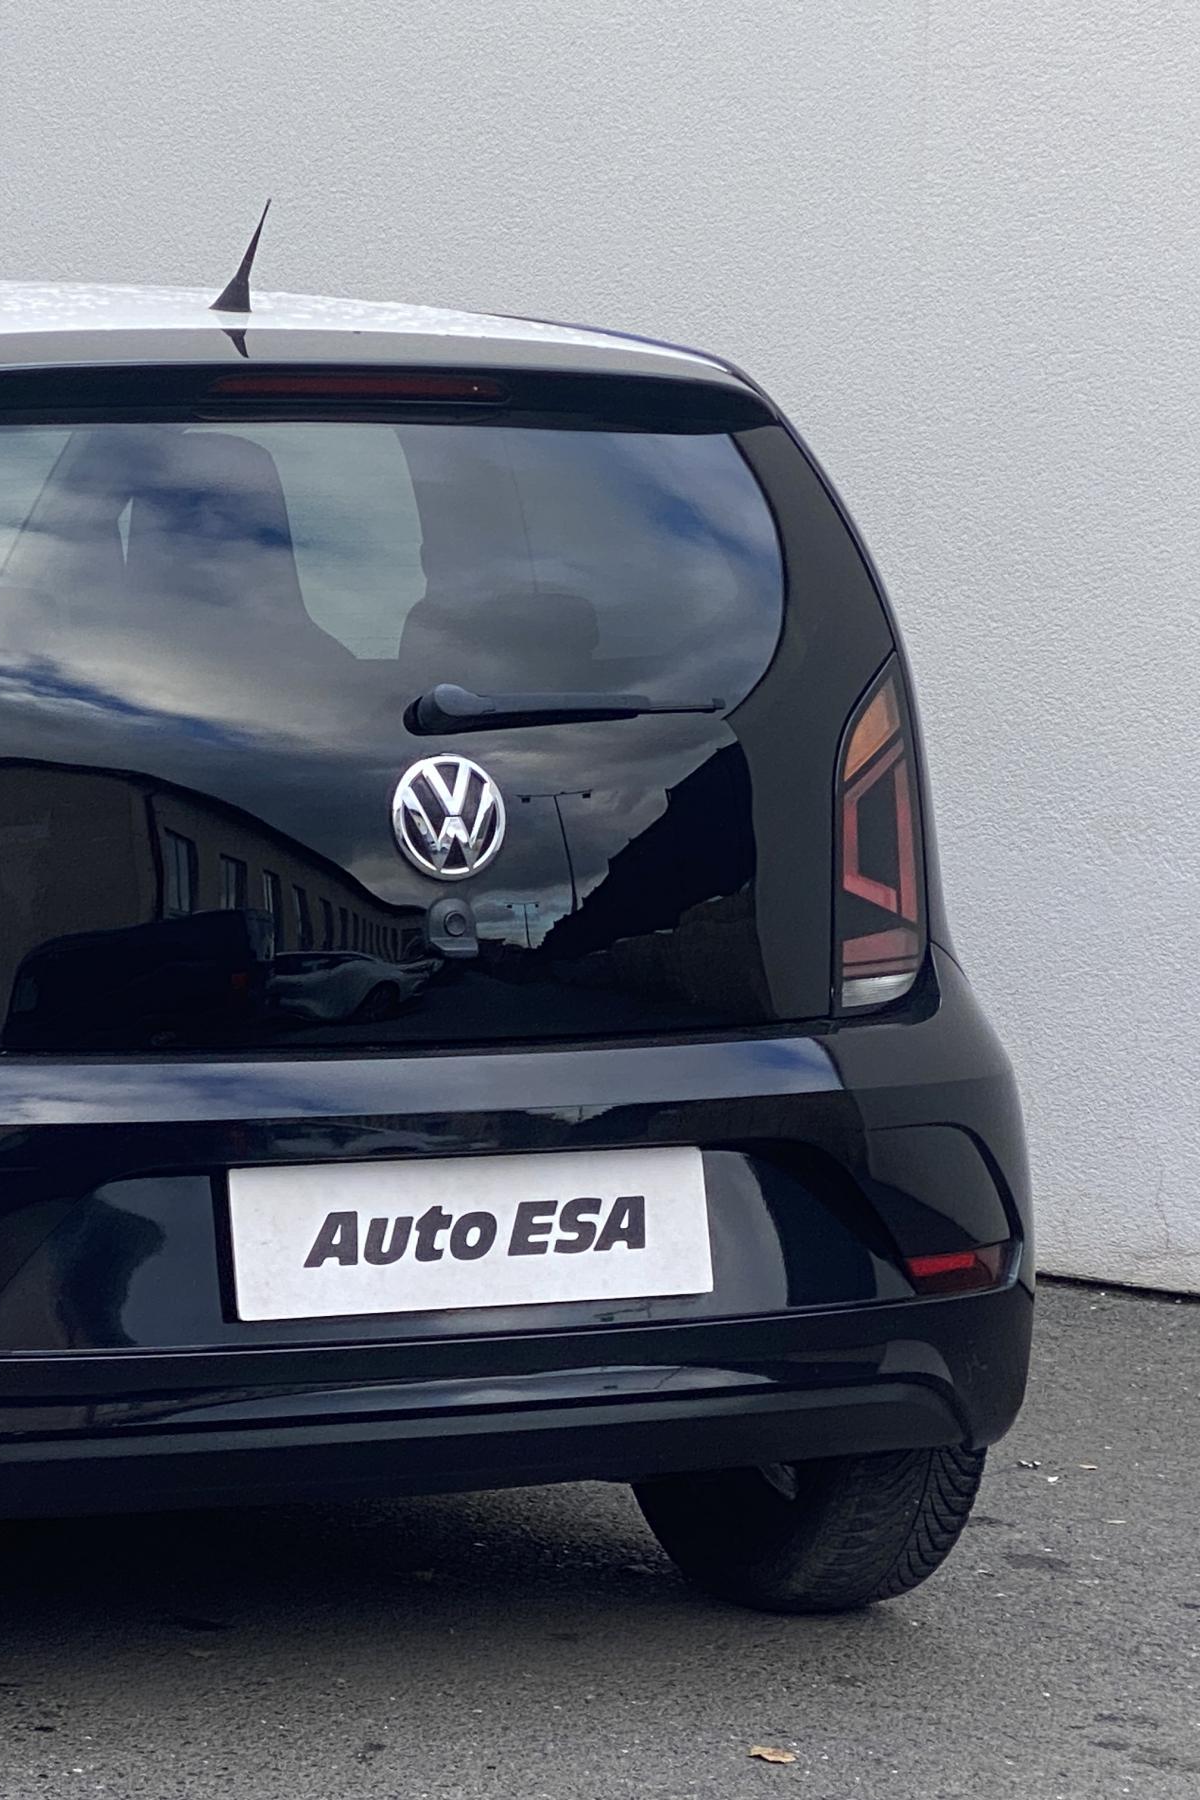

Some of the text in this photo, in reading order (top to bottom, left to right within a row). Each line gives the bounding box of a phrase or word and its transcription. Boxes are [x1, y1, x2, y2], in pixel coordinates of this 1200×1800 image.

[395, 756, 504, 879] VW
[303, 1196, 646, 1268] Auto ESA
